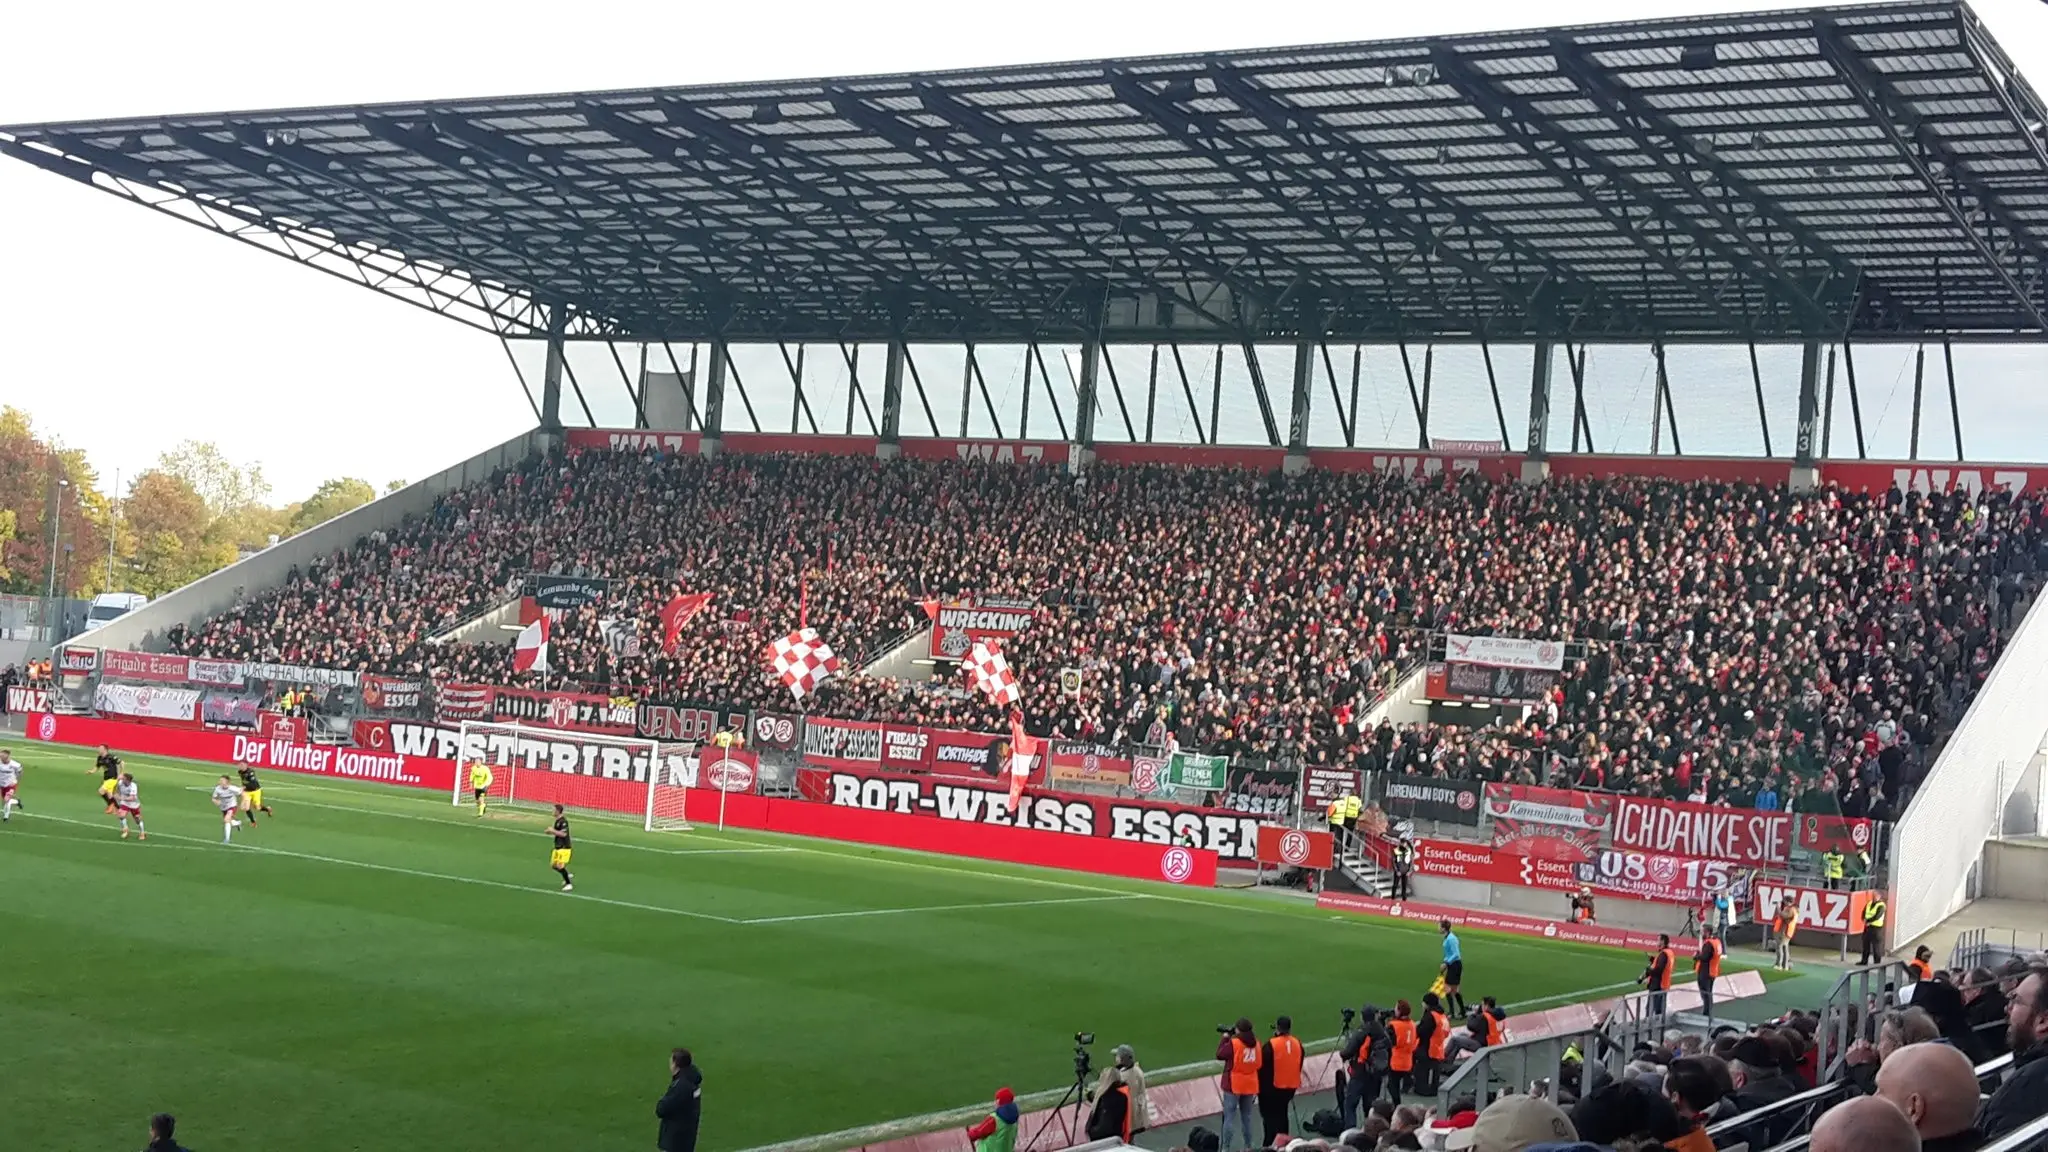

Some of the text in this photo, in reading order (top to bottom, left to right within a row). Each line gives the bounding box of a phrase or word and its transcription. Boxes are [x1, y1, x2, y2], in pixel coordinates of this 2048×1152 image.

[1799, 422, 1812, 434] W
[1799, 437, 1809, 450] 3
[940, 609, 1032, 631] WRECKING
[106, 652, 185, 676] Brigade Essen
[9, 687, 48, 713] WAZ
[370, 726, 384, 748] C
[233, 735, 421, 783] Der Winter kommt...
[390, 723, 700, 788] WESTTRIBÜN
[937, 745, 990, 764] NORTHSIDE
[1385, 779, 1456, 804] ADRENALIN BOYS
[833, 773, 1094, 835] ROT-WEISS
[1509, 803, 1582, 823] Kommilitonen
[1747, 815, 1788, 862] SIE
[1423, 859, 1468, 875] Vernetzt.
[1403, 908, 1442, 922] Sparkasse
[1757, 885, 1848, 930] WAZ
[1558, 929, 1624, 946] Sparkasse Essen
[1243, 1048, 1256, 1063] 24
